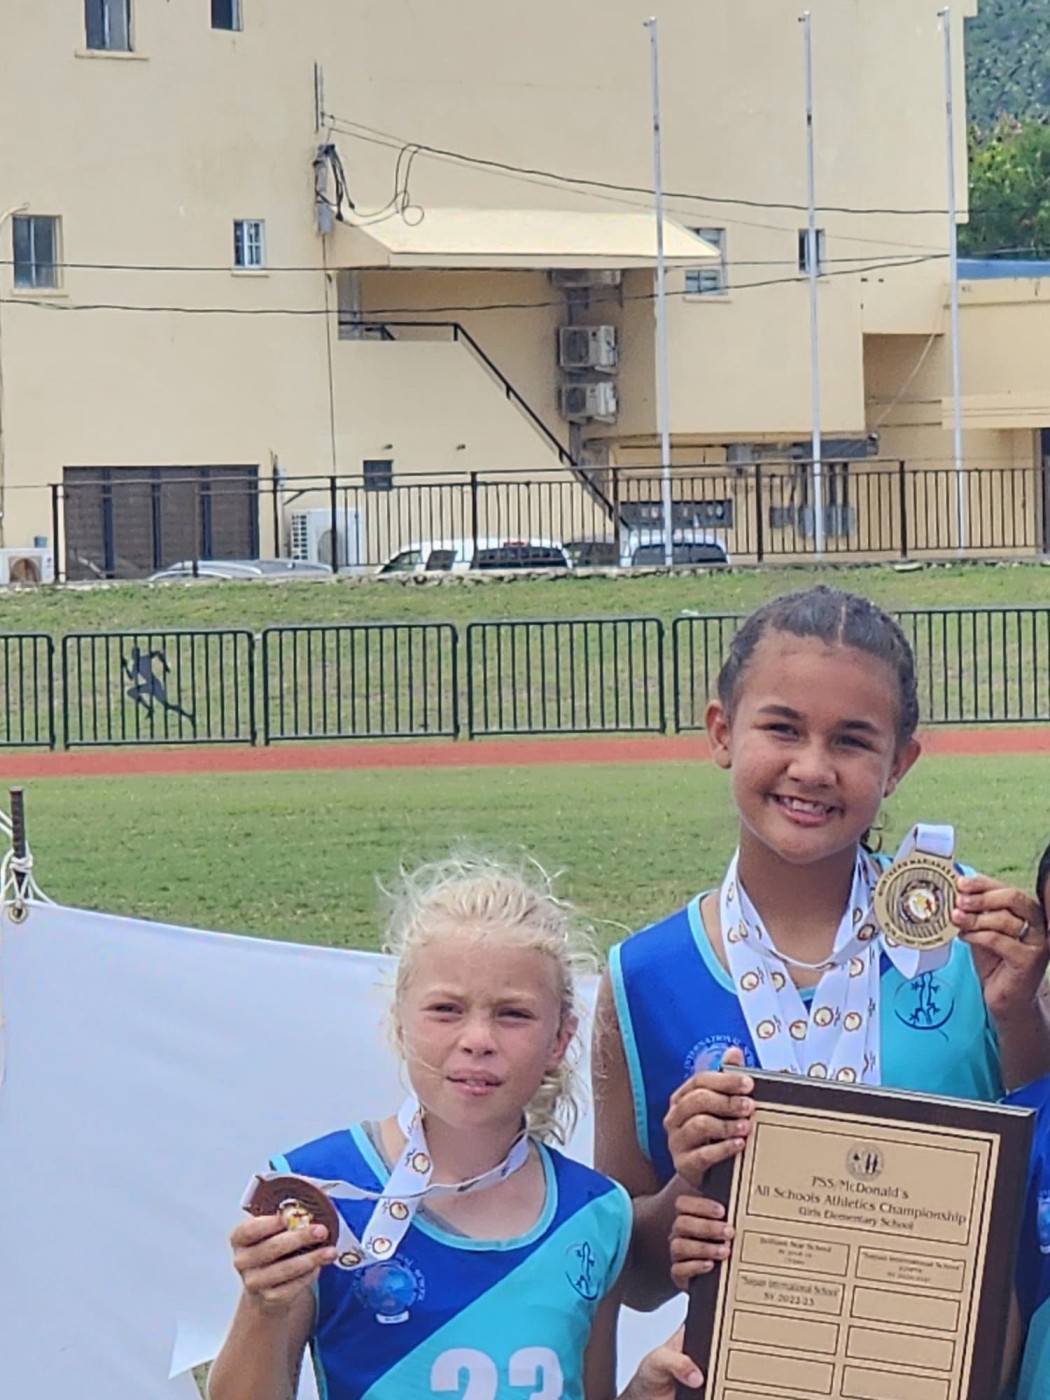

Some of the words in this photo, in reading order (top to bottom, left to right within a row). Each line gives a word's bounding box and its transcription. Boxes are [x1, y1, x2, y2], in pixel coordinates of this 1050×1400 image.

[756, 1184, 771, 1198] All
[773, 1187, 821, 1205] Schools
[824, 1194, 877, 1212] Athletics
[878, 1202, 968, 1228] Championship
[823, 1209, 877, 1228] Elementary
[880, 1217, 915, 1232] School
